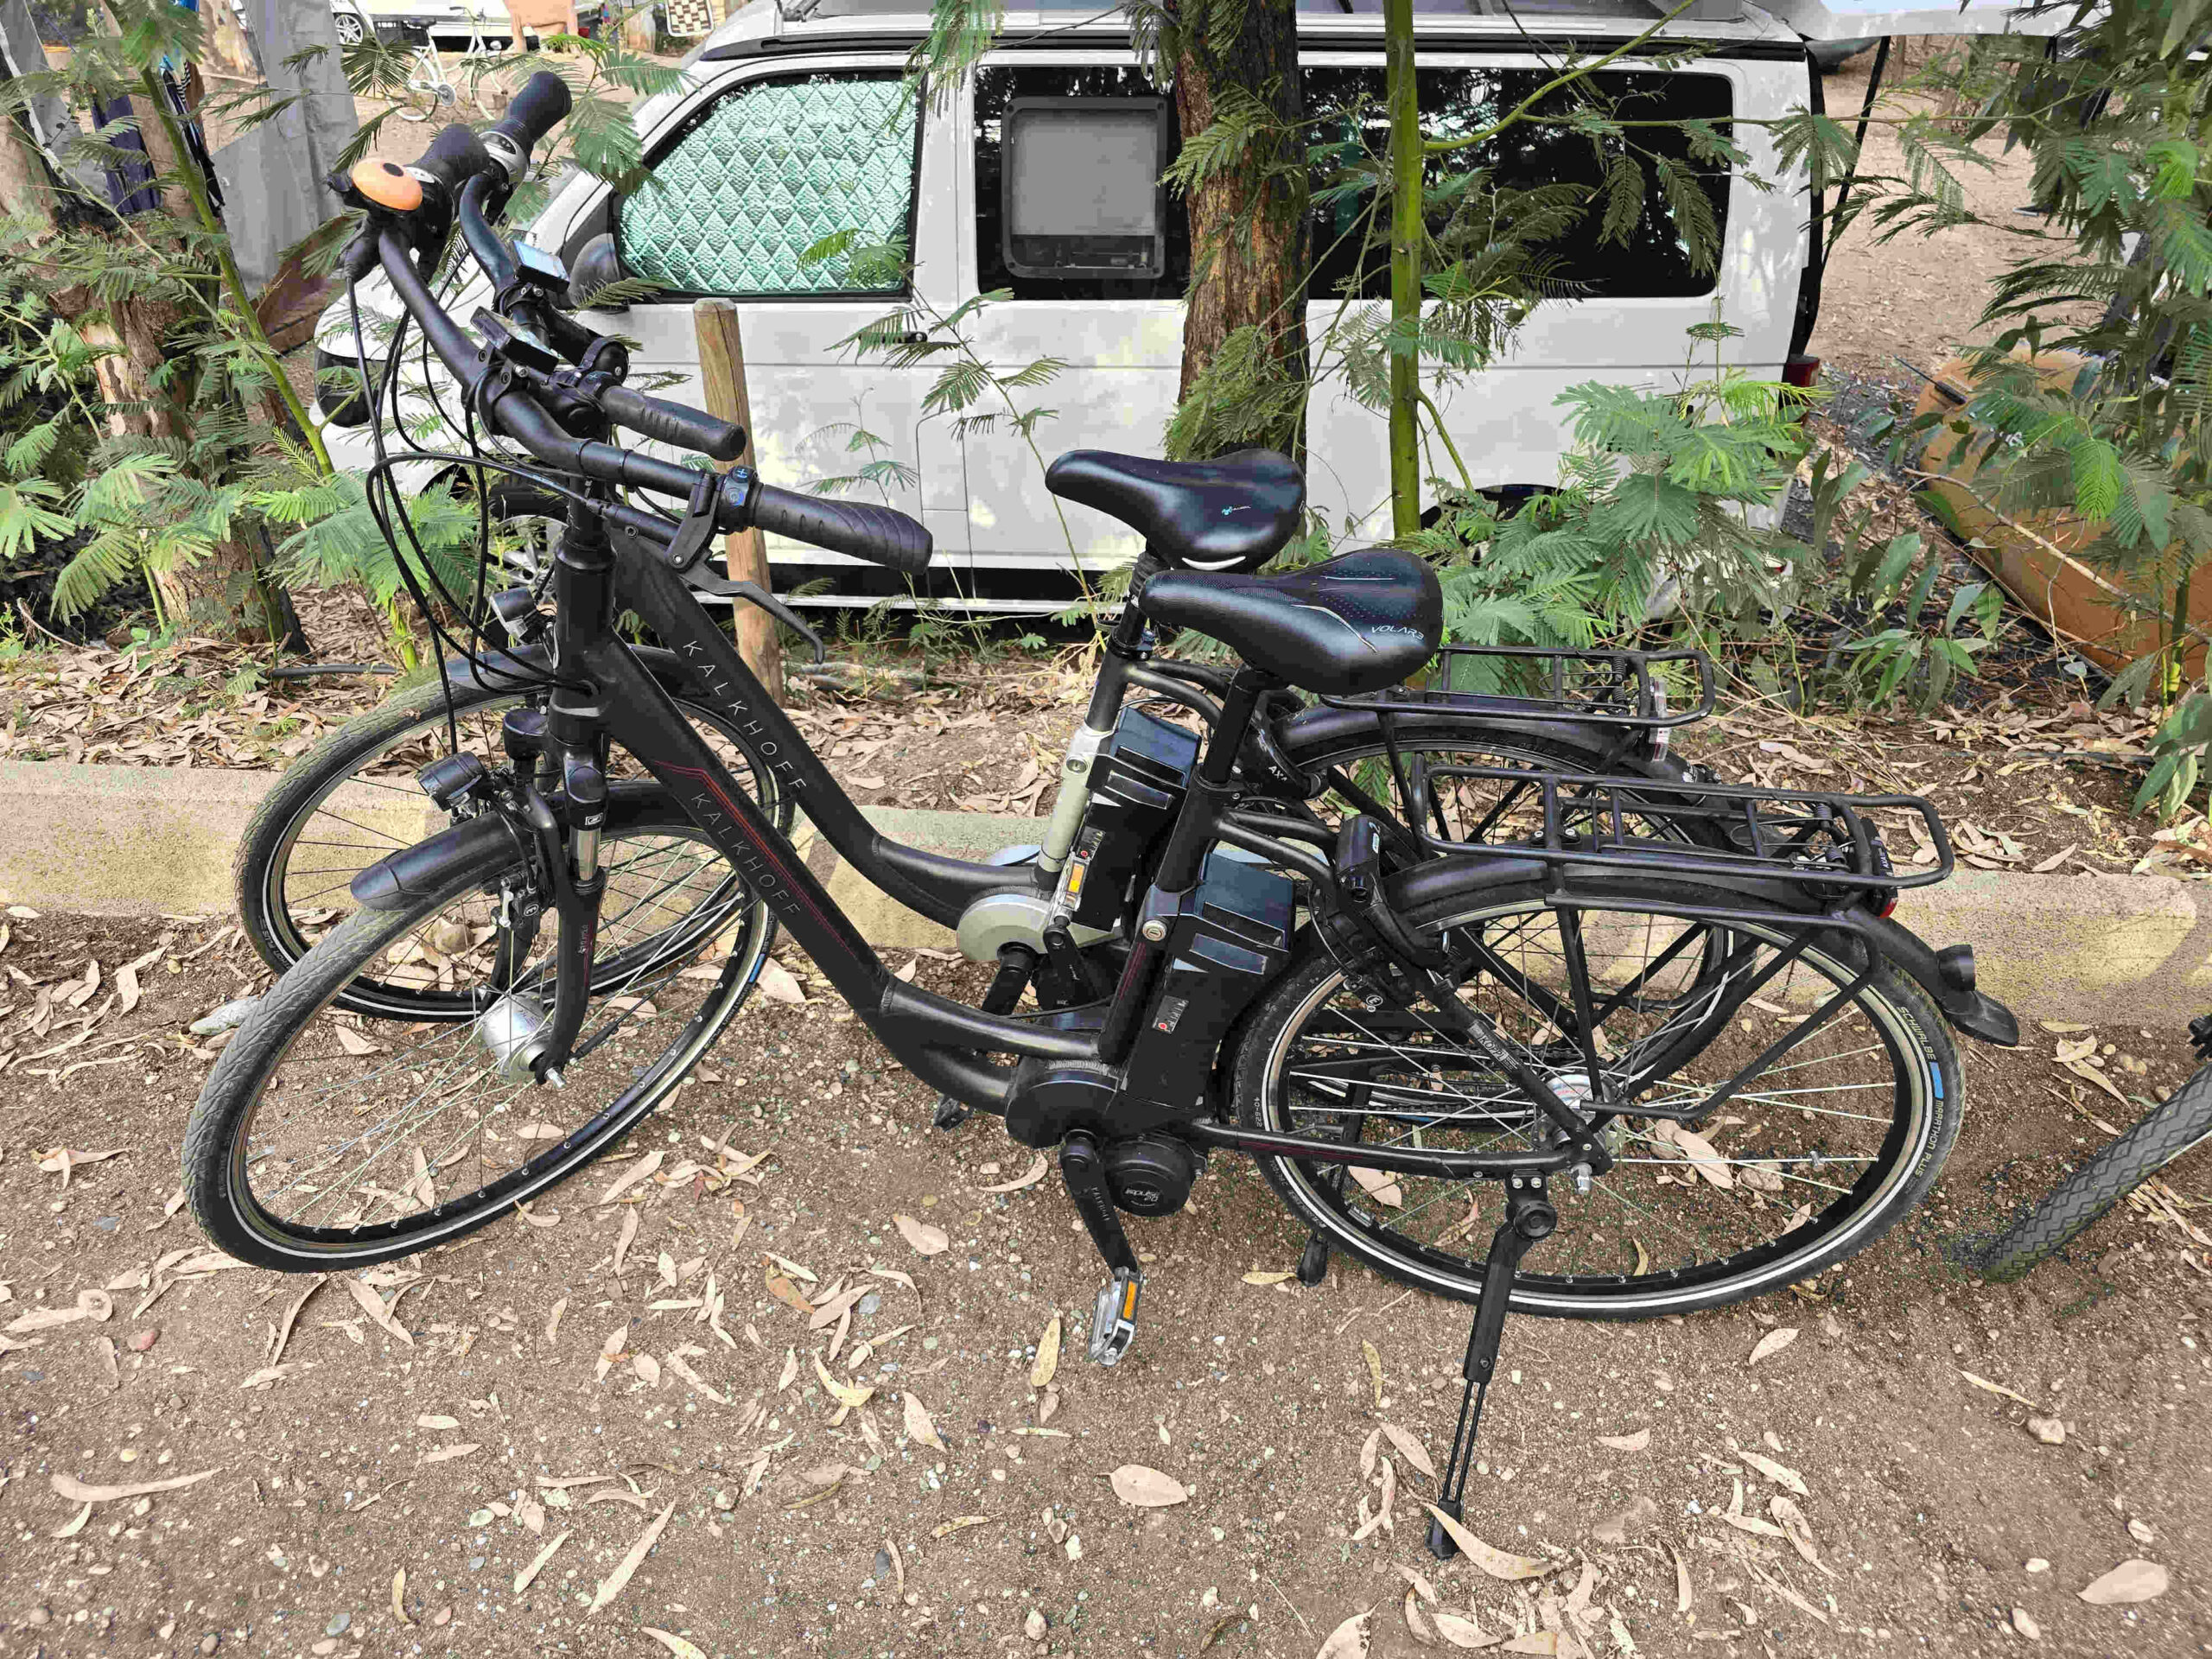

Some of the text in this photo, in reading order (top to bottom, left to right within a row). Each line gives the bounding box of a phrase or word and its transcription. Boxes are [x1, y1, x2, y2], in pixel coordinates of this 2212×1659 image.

[683, 640, 807, 788] KALKHOFF
[691, 792, 802, 916] KALKHOFF
[1897, 1006, 1936, 1060] SCHWALBE
[1915, 1100, 1944, 1177] MARATHON PLUS
